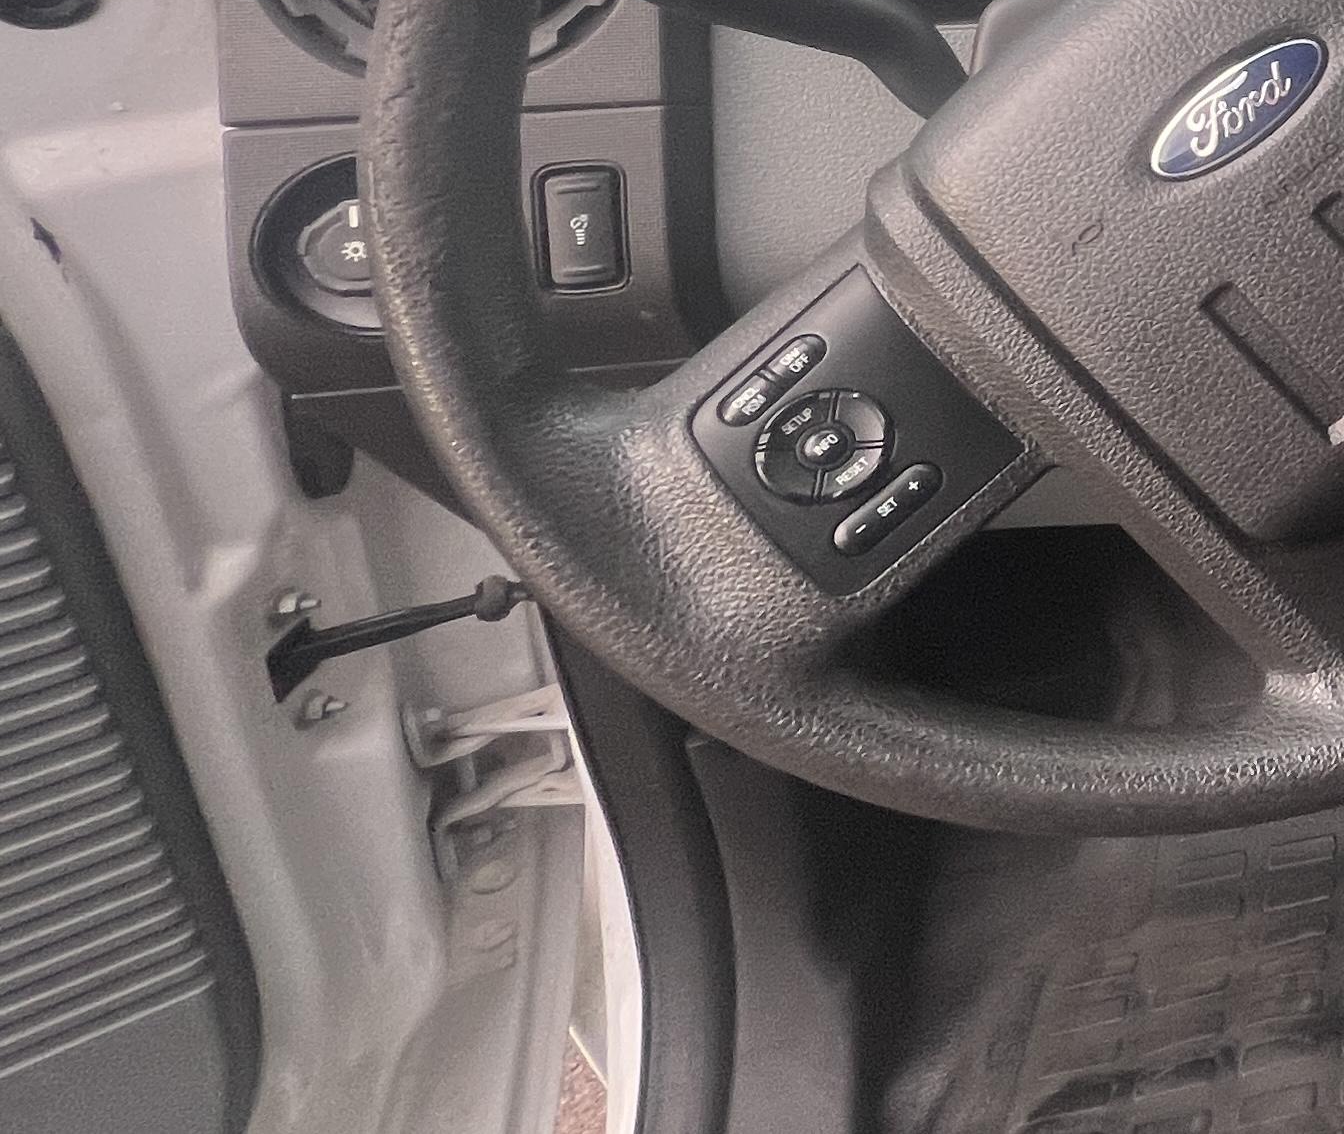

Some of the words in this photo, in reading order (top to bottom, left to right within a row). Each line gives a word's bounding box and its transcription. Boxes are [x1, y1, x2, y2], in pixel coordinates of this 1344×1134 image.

[1186, 60, 1292, 157] Ford
[780, 347, 800, 366] ON
[788, 352, 810, 373] OFF
[781, 407, 813, 435] SETUP
[812, 433, 840, 457] INFO
[835, 456, 870, 486] RESET
[876, 495, 899, 518] SET
